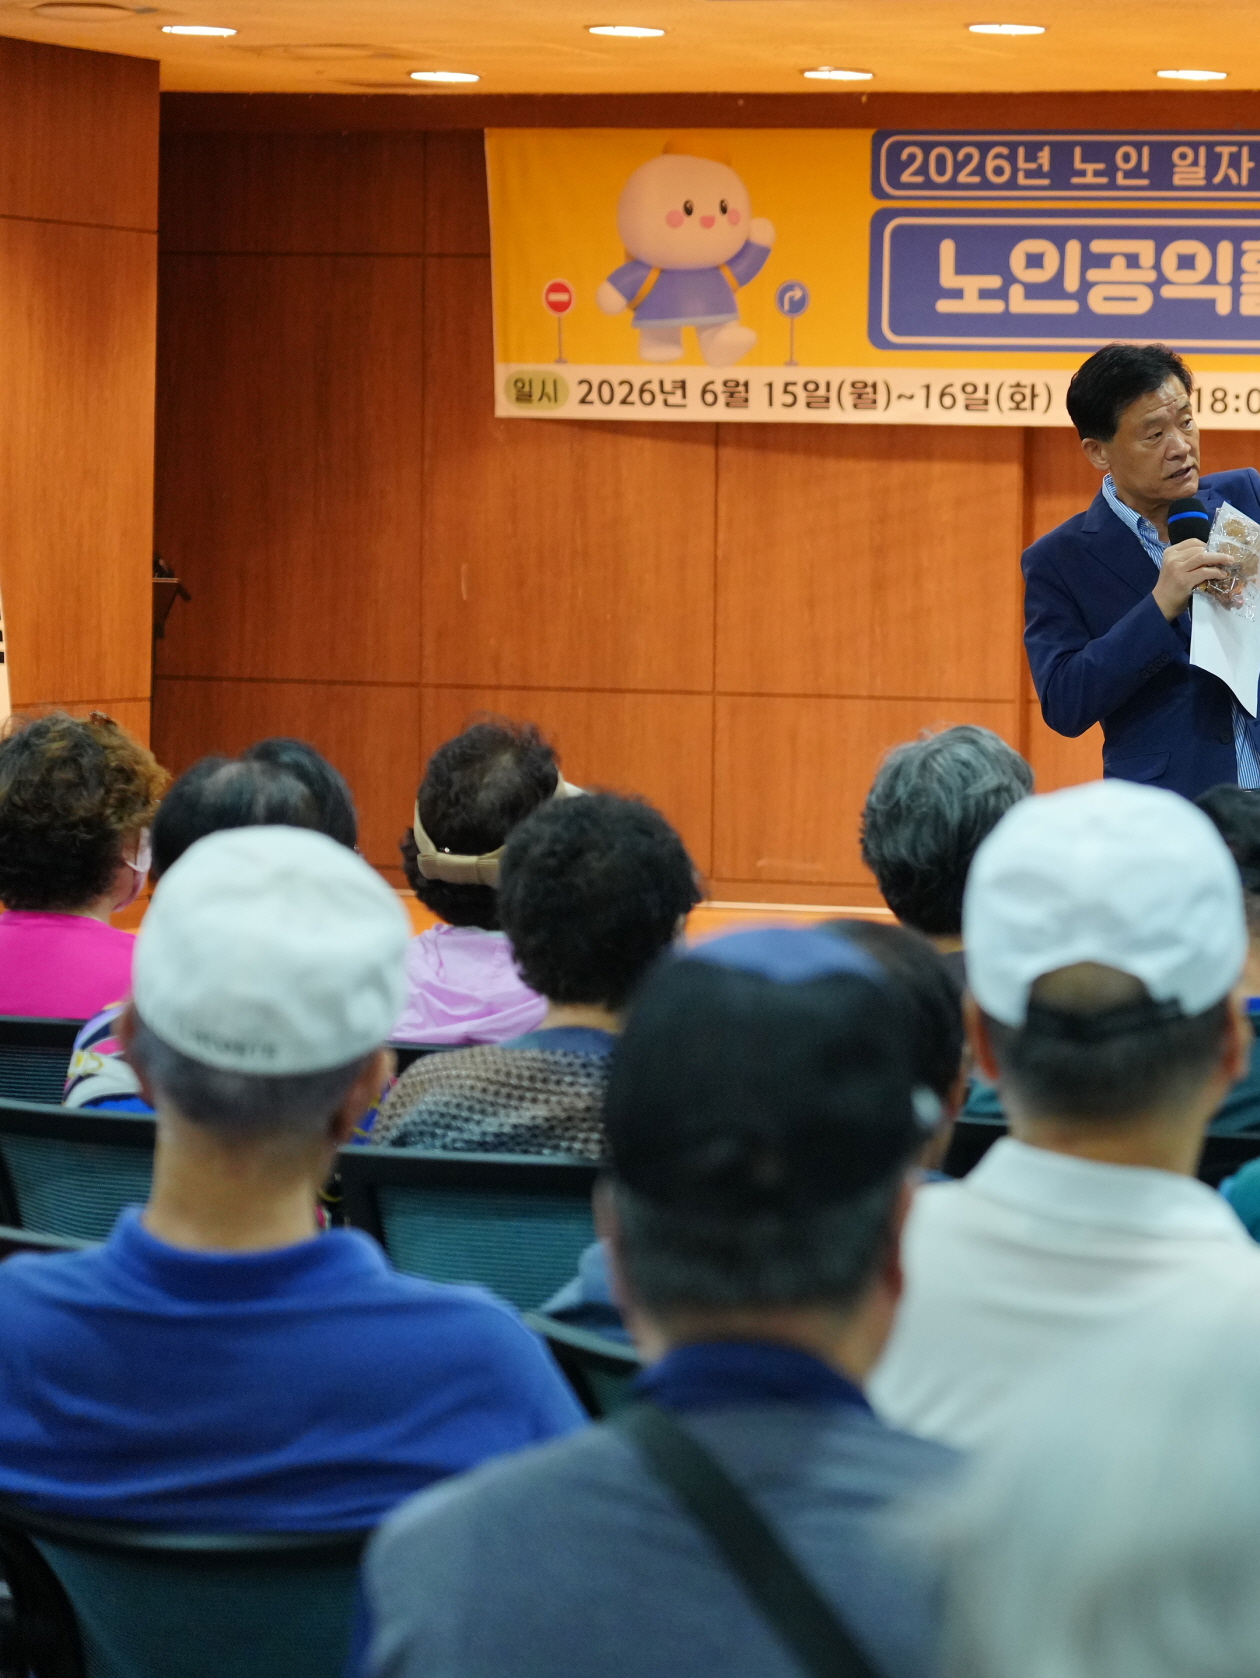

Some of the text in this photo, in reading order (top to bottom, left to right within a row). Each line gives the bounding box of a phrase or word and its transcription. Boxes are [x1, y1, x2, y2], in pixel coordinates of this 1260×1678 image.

[899, 145, 1051, 185] 2026년
[1069, 145, 1151, 186] 노인
[513, 377, 558, 404] 일시
[577, 378, 687, 408] 2026년
[700, 378, 750, 409] 6월
[764, 379, 1052, 414] 15일(월)~16일(화)
